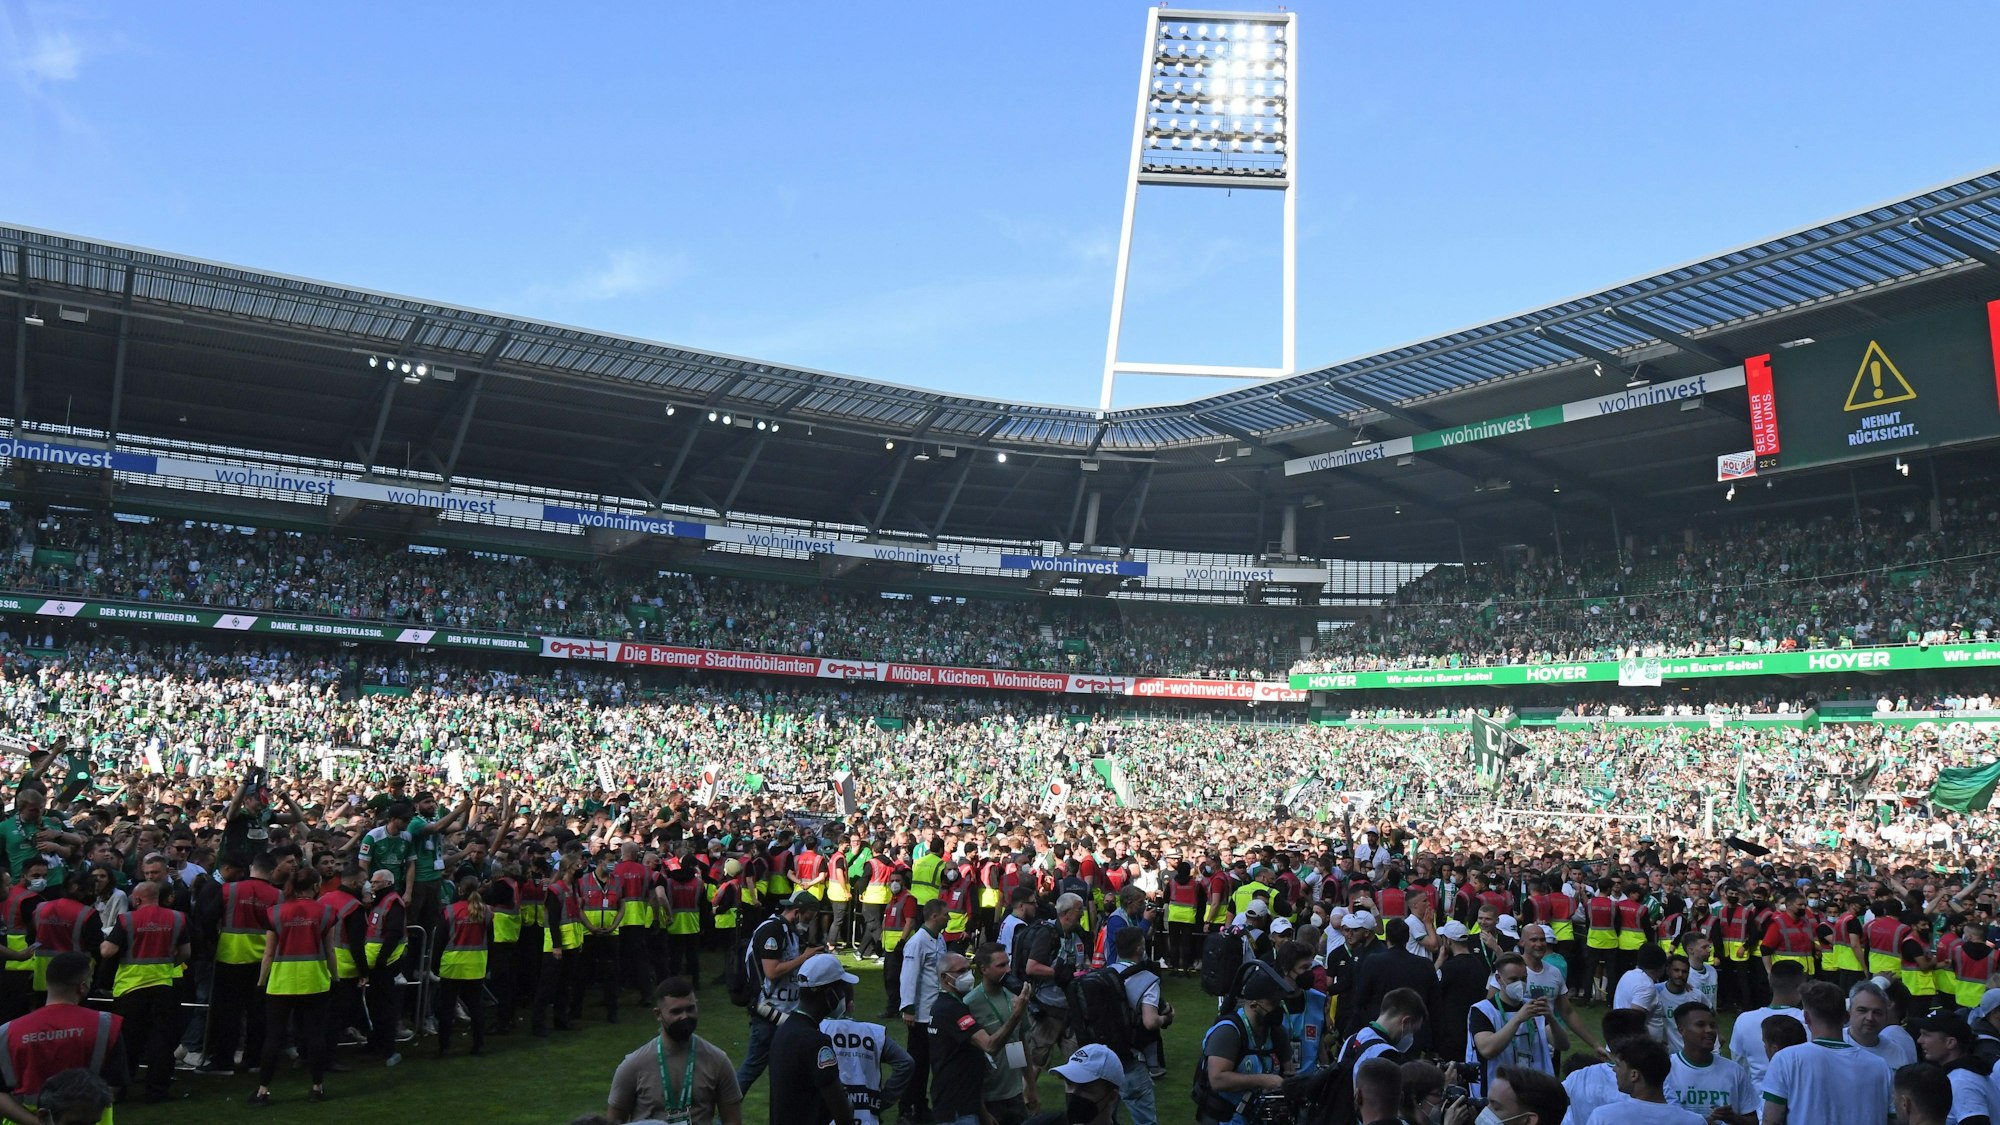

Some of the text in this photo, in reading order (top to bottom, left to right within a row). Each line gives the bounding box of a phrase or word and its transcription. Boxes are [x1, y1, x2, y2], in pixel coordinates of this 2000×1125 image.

[1598, 375, 1707, 414] wohninvest
[1751, 394, 1765, 453] SEI EINER
[1762, 390, 1776, 451] VON UNS.
[1861, 411, 1901, 429] NEHMT
[1440, 413, 1532, 447] wohninvest
[1848, 423, 1920, 446] RÜCKSICHT.
[0, 439, 113, 469] ohninvest
[1308, 444, 1386, 471] wohninvest
[215, 468, 335, 495] wohninvest
[387, 488, 496, 514] wohninvest
[577, 511, 675, 536] wohninvest
[747, 532, 835, 554] wohninvest
[873, 547, 961, 566] wohninvest
[1030, 557, 1119, 575] wohninvest
[1186, 566, 1274, 582] wohninvest
[100, 607, 200, 623] DER SVW IST WIEDER DA.
[271, 621, 384, 638] DANKE. IHR SEID ERSTKLASSIG.
[447, 635, 461, 643] DER
[462, 636, 478, 645] SVW
[479, 637, 491, 646] IST
[492, 638, 517, 648] WIEDER
[623, 645, 815, 674] Die Bremer Stadtmöbilanten
[1808, 651, 1891, 669] HOYER
[1943, 650, 1972, 661] Wir
[1527, 665, 1588, 681] HOYER
[1673, 665, 1688, 673] an
[1690, 662, 1725, 673] Eurer
[1726, 660, 1763, 671] Seite!
[891, 665, 1063, 690] Möbel, Küchen, Wohnideen
[1309, 675, 1357, 688] HOYER
[1387, 675, 1402, 684] Wir
[1403, 674, 1423, 683] sind
[1437, 673, 1463, 682] Eurer
[1464, 672, 1493, 681] Seite!
[1139, 681, 1254, 698] opti-wohnwelt.de
[22, 1027, 85, 1044] SECURITY
[1676, 1086, 1730, 1107] LÖPPT
